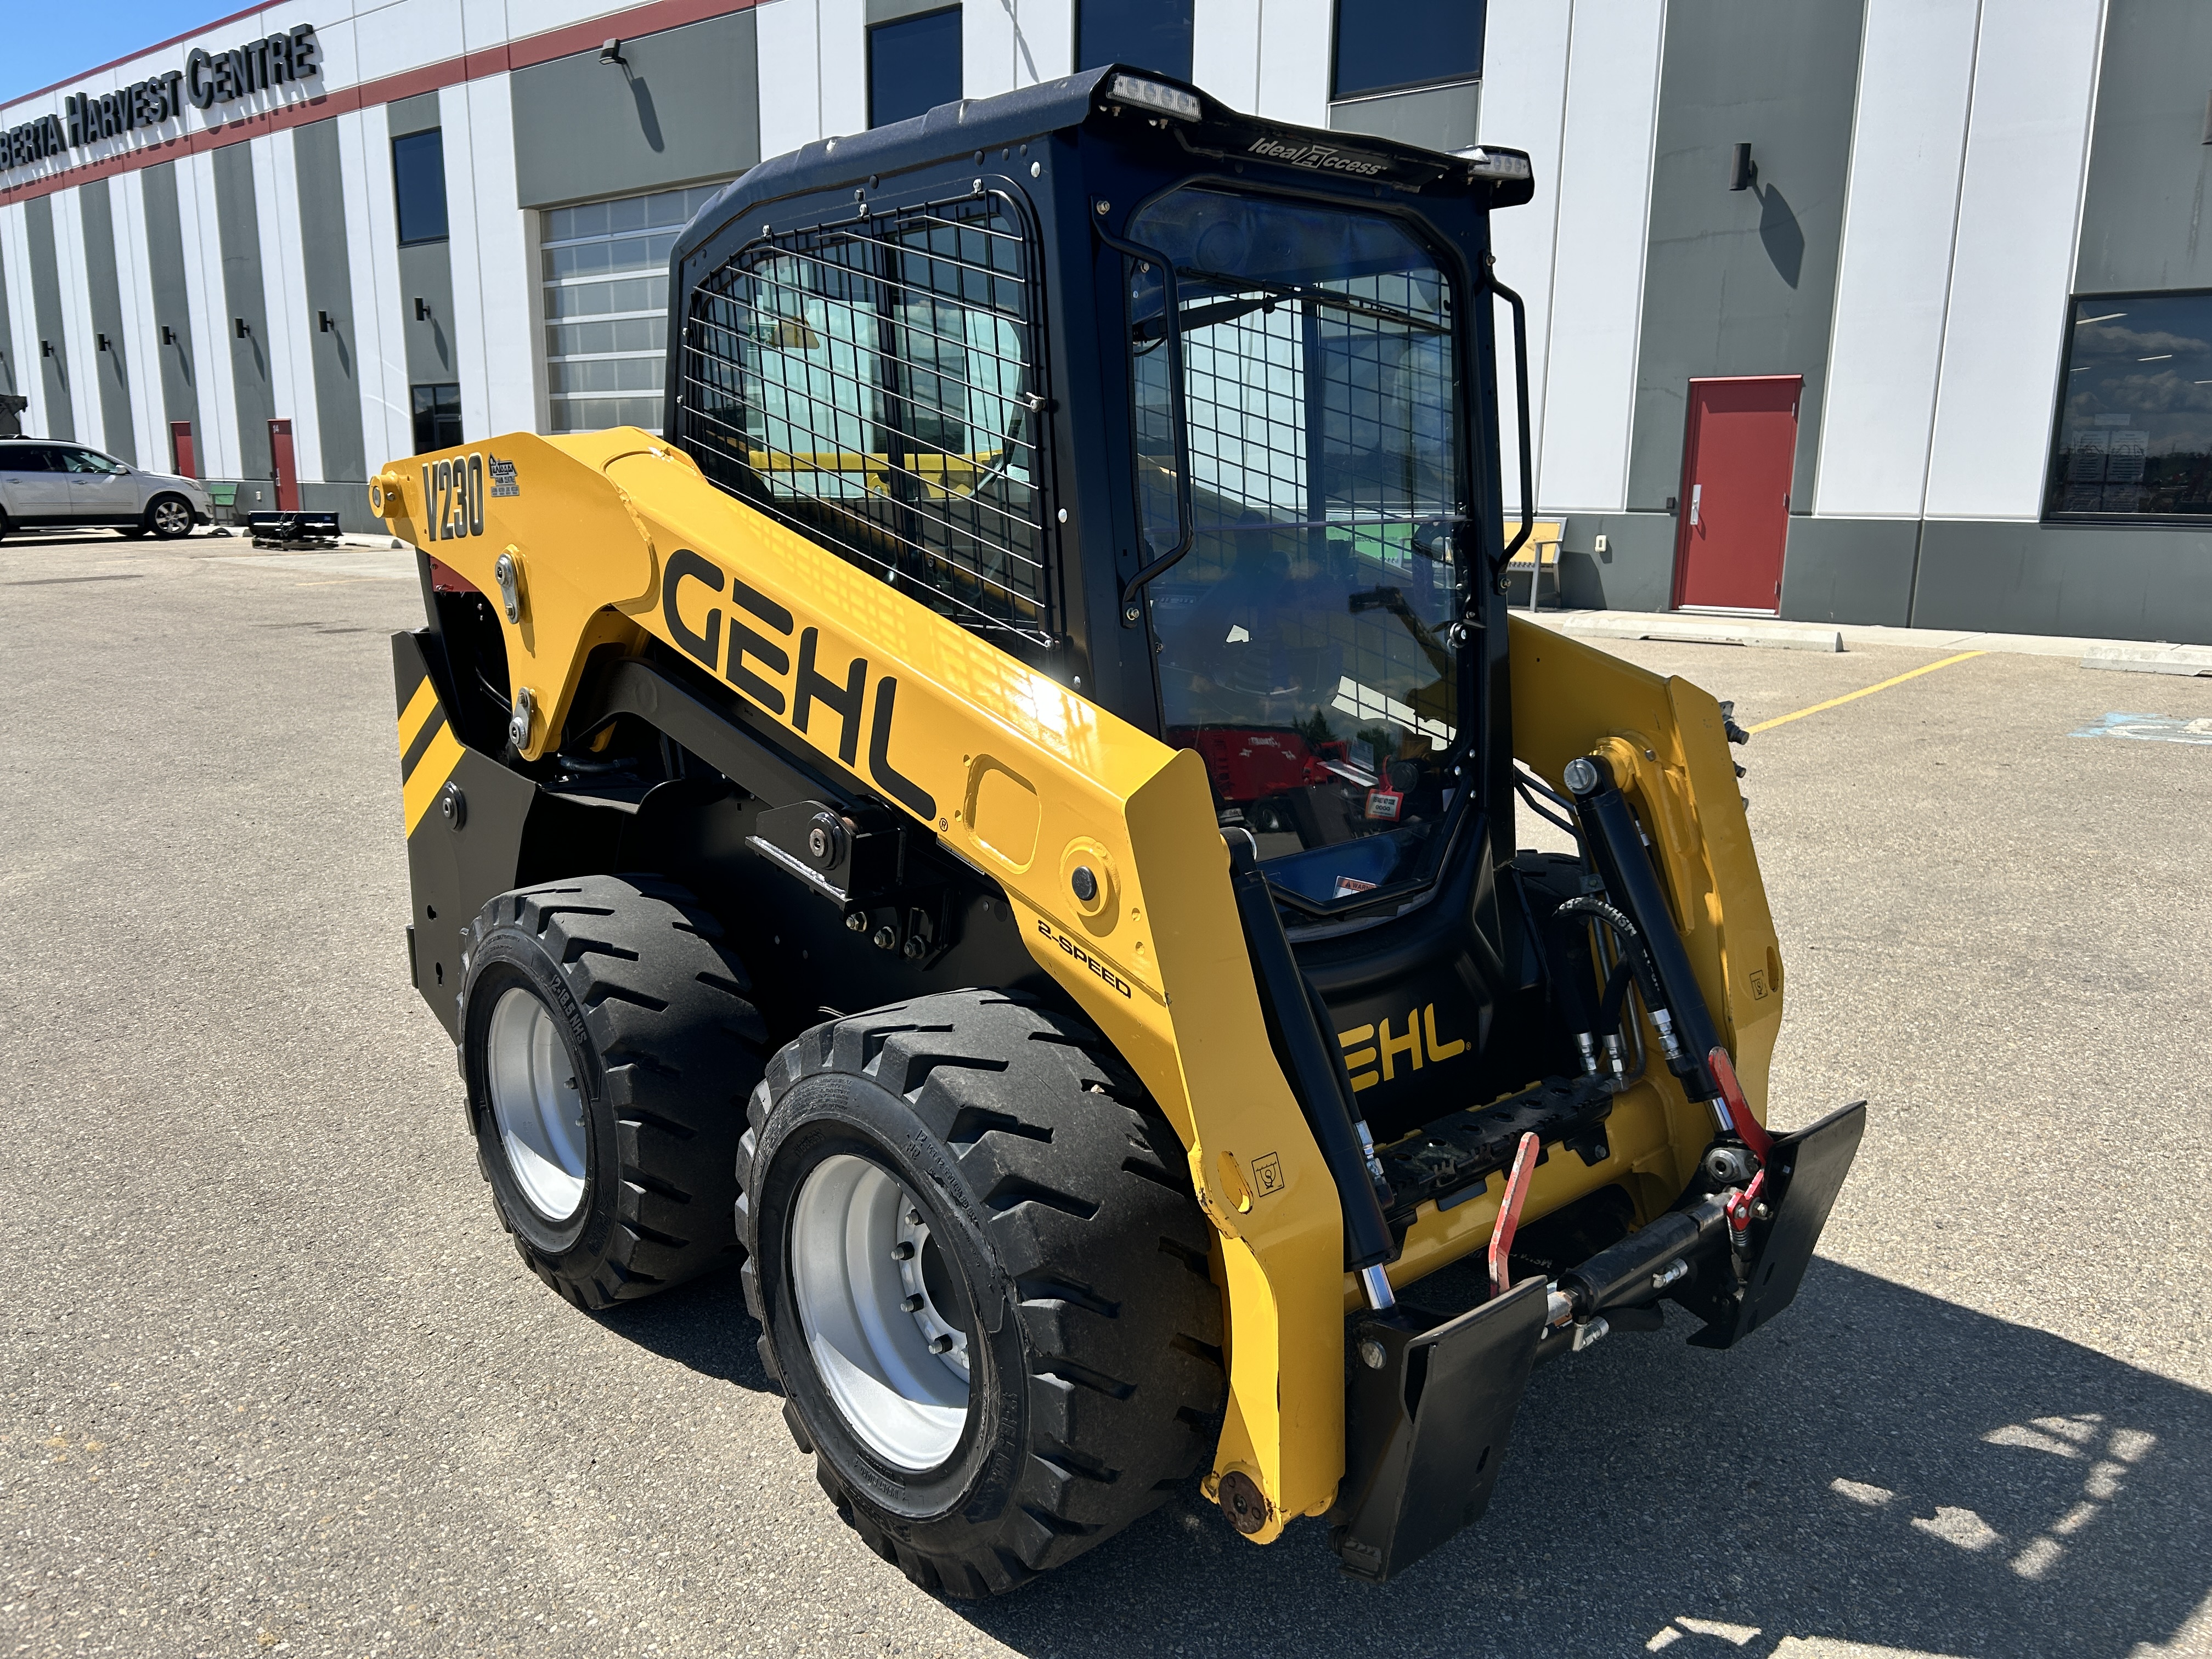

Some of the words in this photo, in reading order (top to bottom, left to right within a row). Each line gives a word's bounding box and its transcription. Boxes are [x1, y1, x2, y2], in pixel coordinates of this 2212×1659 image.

[64, 70, 183, 148] HARVEST
[186, 24, 317, 110] CENTRE
[422, 452, 484, 542] V230
[663, 549, 937, 821] GEHL
[1038, 919, 1131, 999] 2-SPEED
[570, 1013, 588, 1045] NHS
[1338, 1003, 1465, 1092] EHL
